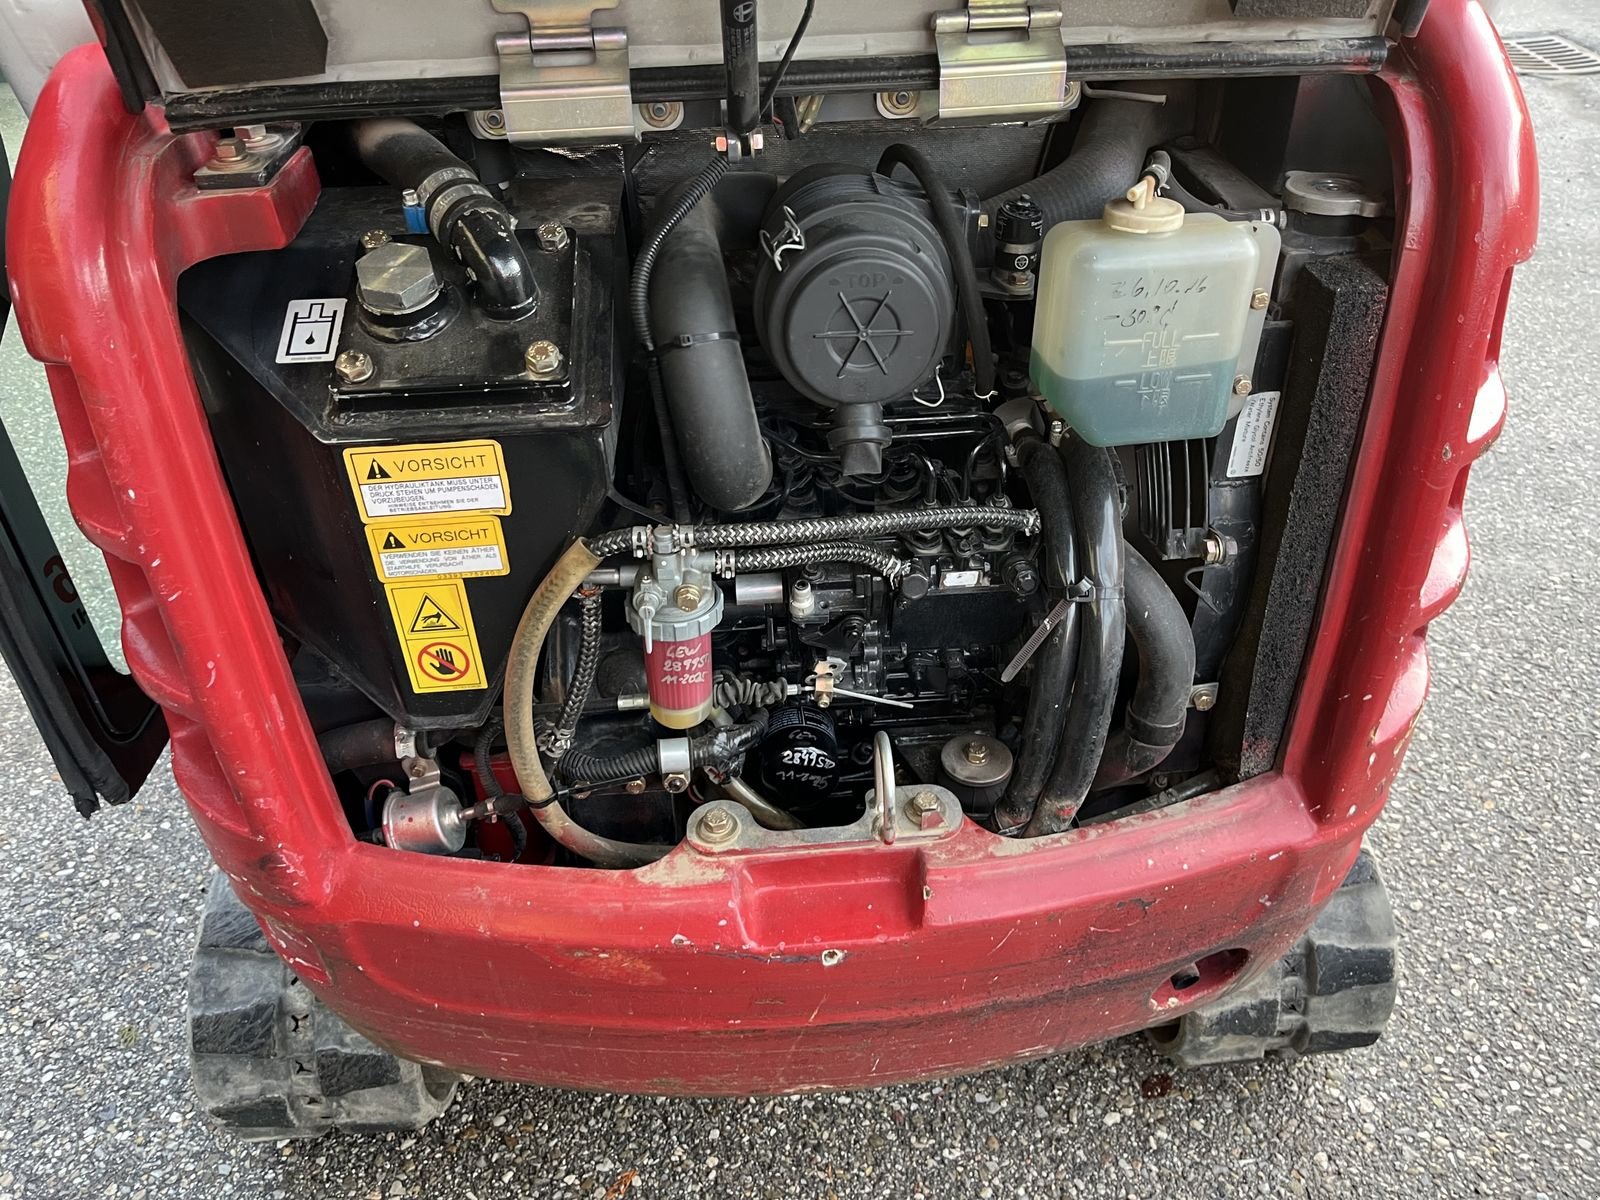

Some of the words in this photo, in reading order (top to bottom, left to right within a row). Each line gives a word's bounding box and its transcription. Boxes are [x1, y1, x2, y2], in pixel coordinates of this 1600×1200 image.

[847, 271, 889, 289] TOP
[1141, 330, 1181, 352] FULL
[1140, 370, 1174, 390] LOW
[1266, 397, 1276, 418] System
[393, 455, 487, 473] VORSICHT
[385, 481, 445, 490] HYDRAULIKTANK
[469, 477, 493, 485] UNTER
[370, 490, 395, 498] DRUCK
[396, 488, 423, 496] STEHEN
[408, 528, 489, 544] VORSICHT
[384, 551, 428, 559] VERWENDEN
